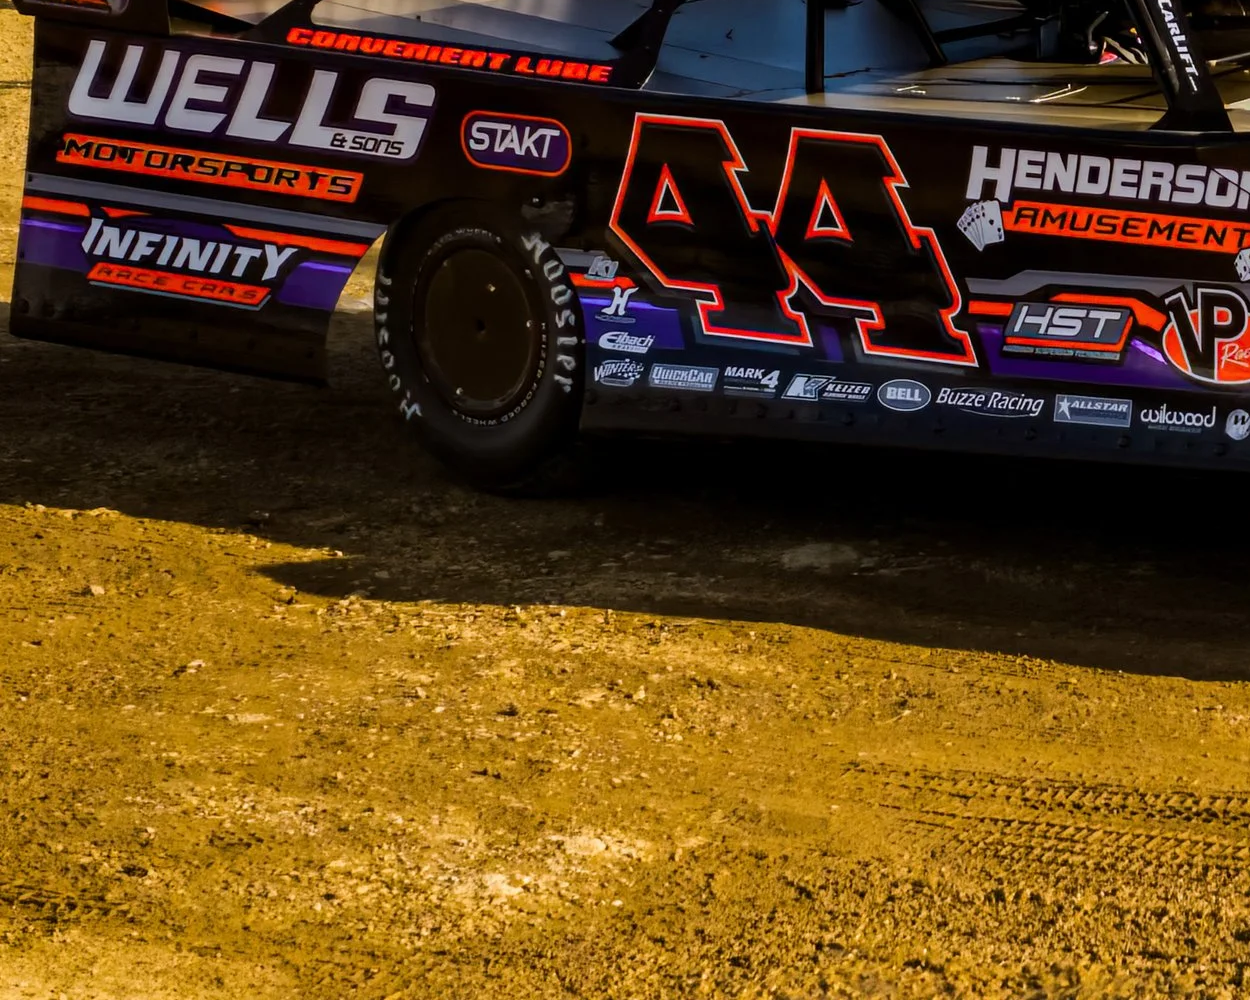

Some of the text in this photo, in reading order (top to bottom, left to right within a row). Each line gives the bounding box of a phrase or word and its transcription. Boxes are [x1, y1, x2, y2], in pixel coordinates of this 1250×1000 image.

[286, 27, 613, 82] CONVENIENT LUBE
[68, 39, 437, 160] WELLS
[330, 132, 347, 149] &
[468, 120, 560, 159] STAKT
[63, 138, 357, 196] MOTORSPORTS
[81, 217, 299, 281] INFINITY
[97, 265, 260, 301] RACE CARS
[1013, 305, 1122, 339] HST
[1164, 286, 1249, 384] VP
[599, 331, 655, 350] Eibach
[724, 366, 765, 380] MARK
[760, 369, 781, 389] 4
[886, 386, 922, 402] BELL
[935, 387, 986, 407] Buzze
[987, 391, 1045, 416] Racing
[1070, 400, 1129, 413] ALLSTAR
[1140, 403, 1217, 428] wilwood
